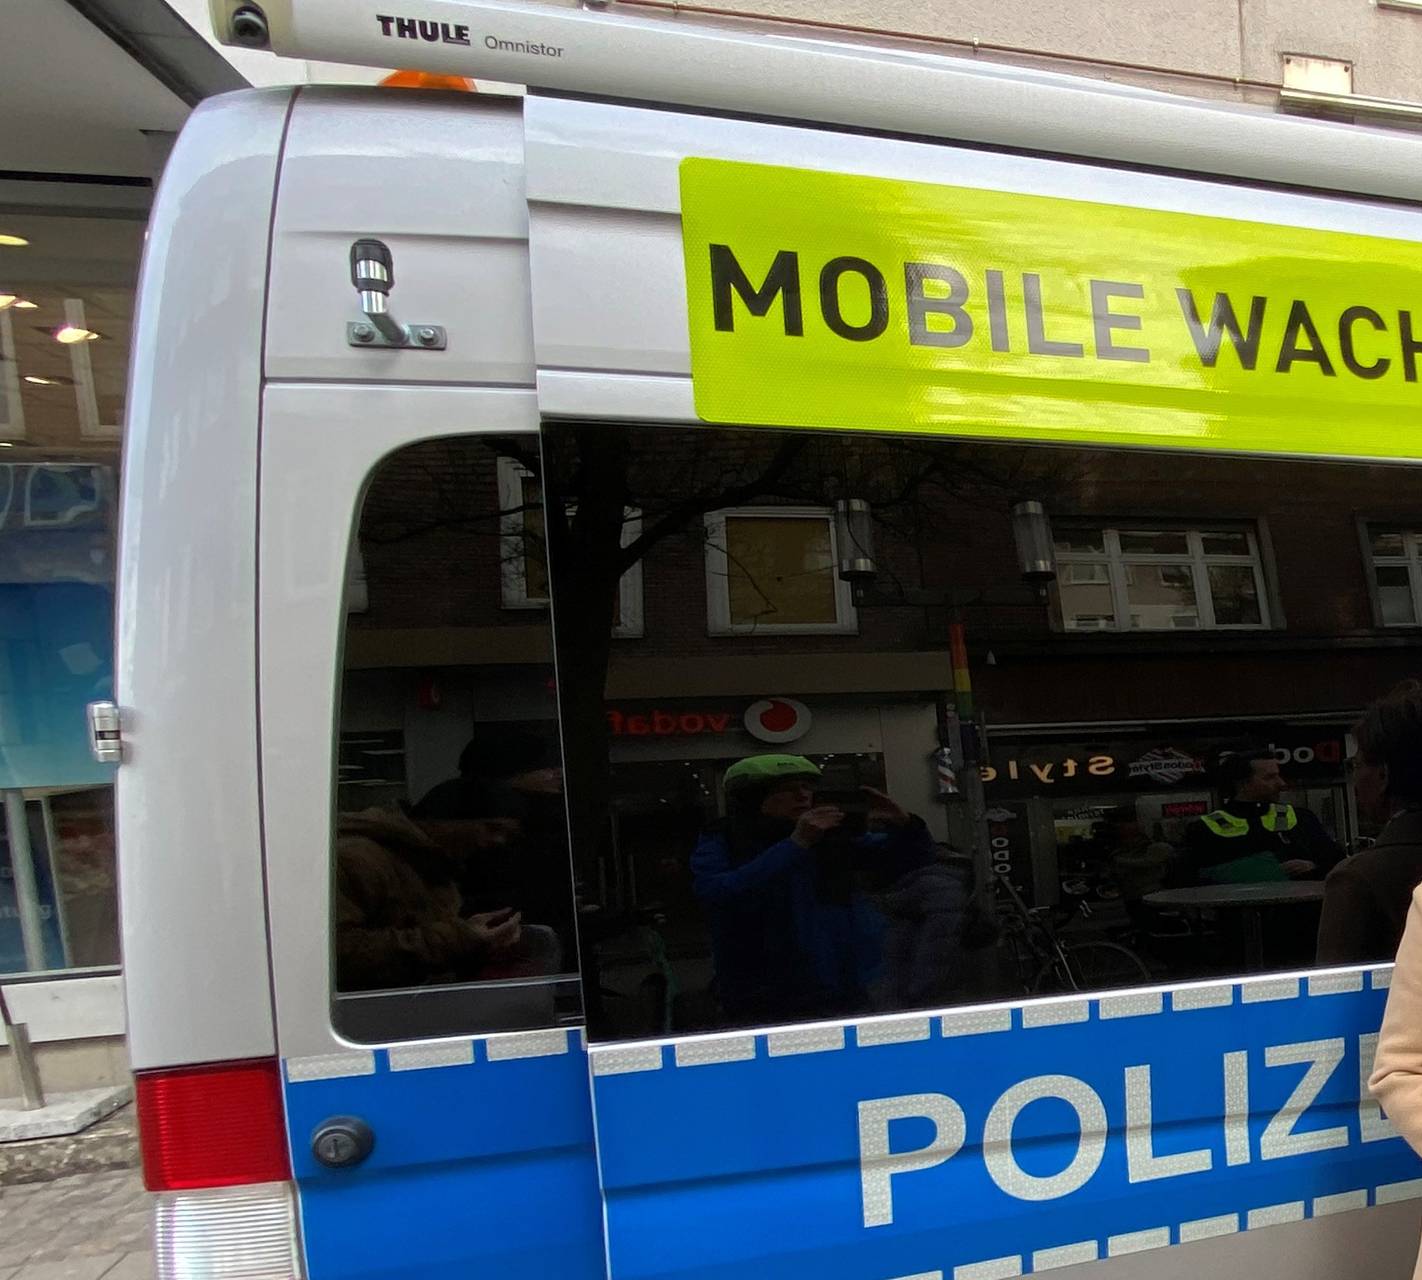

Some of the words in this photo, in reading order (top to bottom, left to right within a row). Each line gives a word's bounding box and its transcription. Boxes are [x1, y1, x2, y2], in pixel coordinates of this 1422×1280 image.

[376, 14, 470, 46] THULE
[485, 36, 564, 57] Omnistor
[709, 243, 1150, 363] MOBILE
